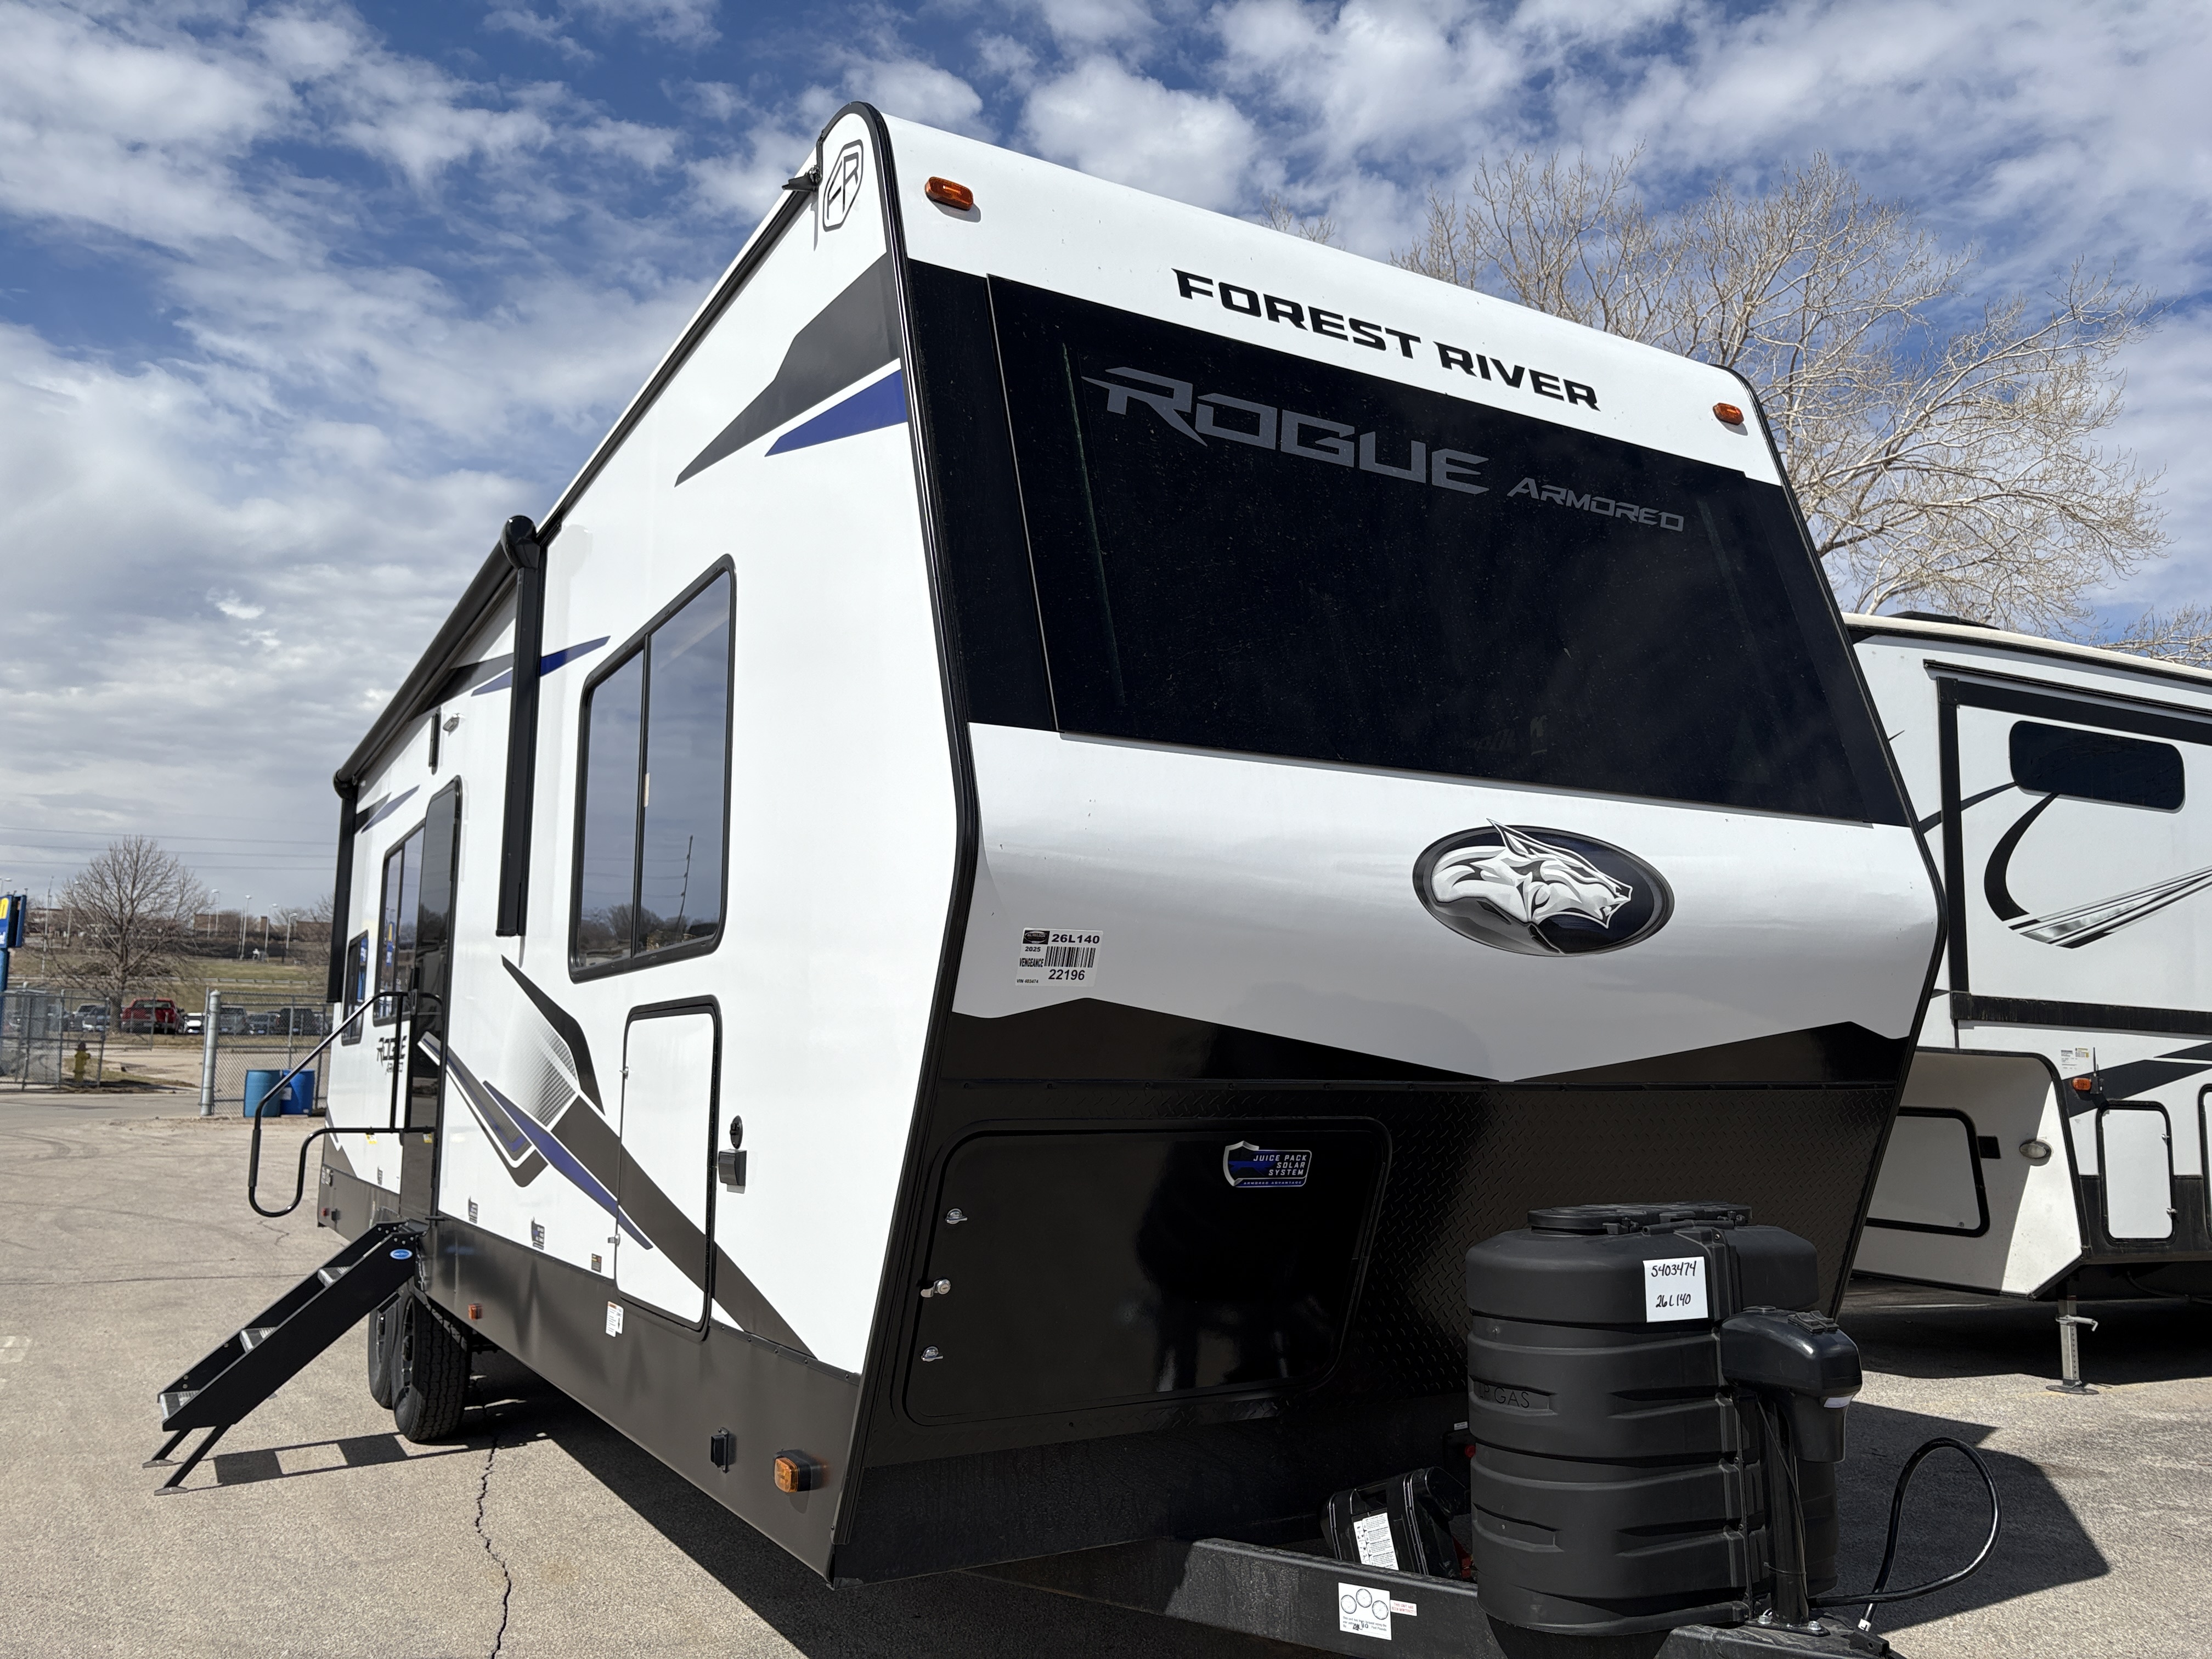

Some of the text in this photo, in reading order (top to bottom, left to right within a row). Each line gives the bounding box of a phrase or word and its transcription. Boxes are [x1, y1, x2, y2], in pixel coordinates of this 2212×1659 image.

[1171, 268, 1601, 411] FOREST RIVER
[1081, 366, 1684, 532] ROGUE ARMORED
[1051, 934, 1100, 944] 26L140
[1019, 958, 1044, 967] VENGEANCE
[1048, 969, 1085, 980] 22196
[1651, 1260, 1697, 1277] 5403474
[1494, 1386, 1530, 1408] GAS
